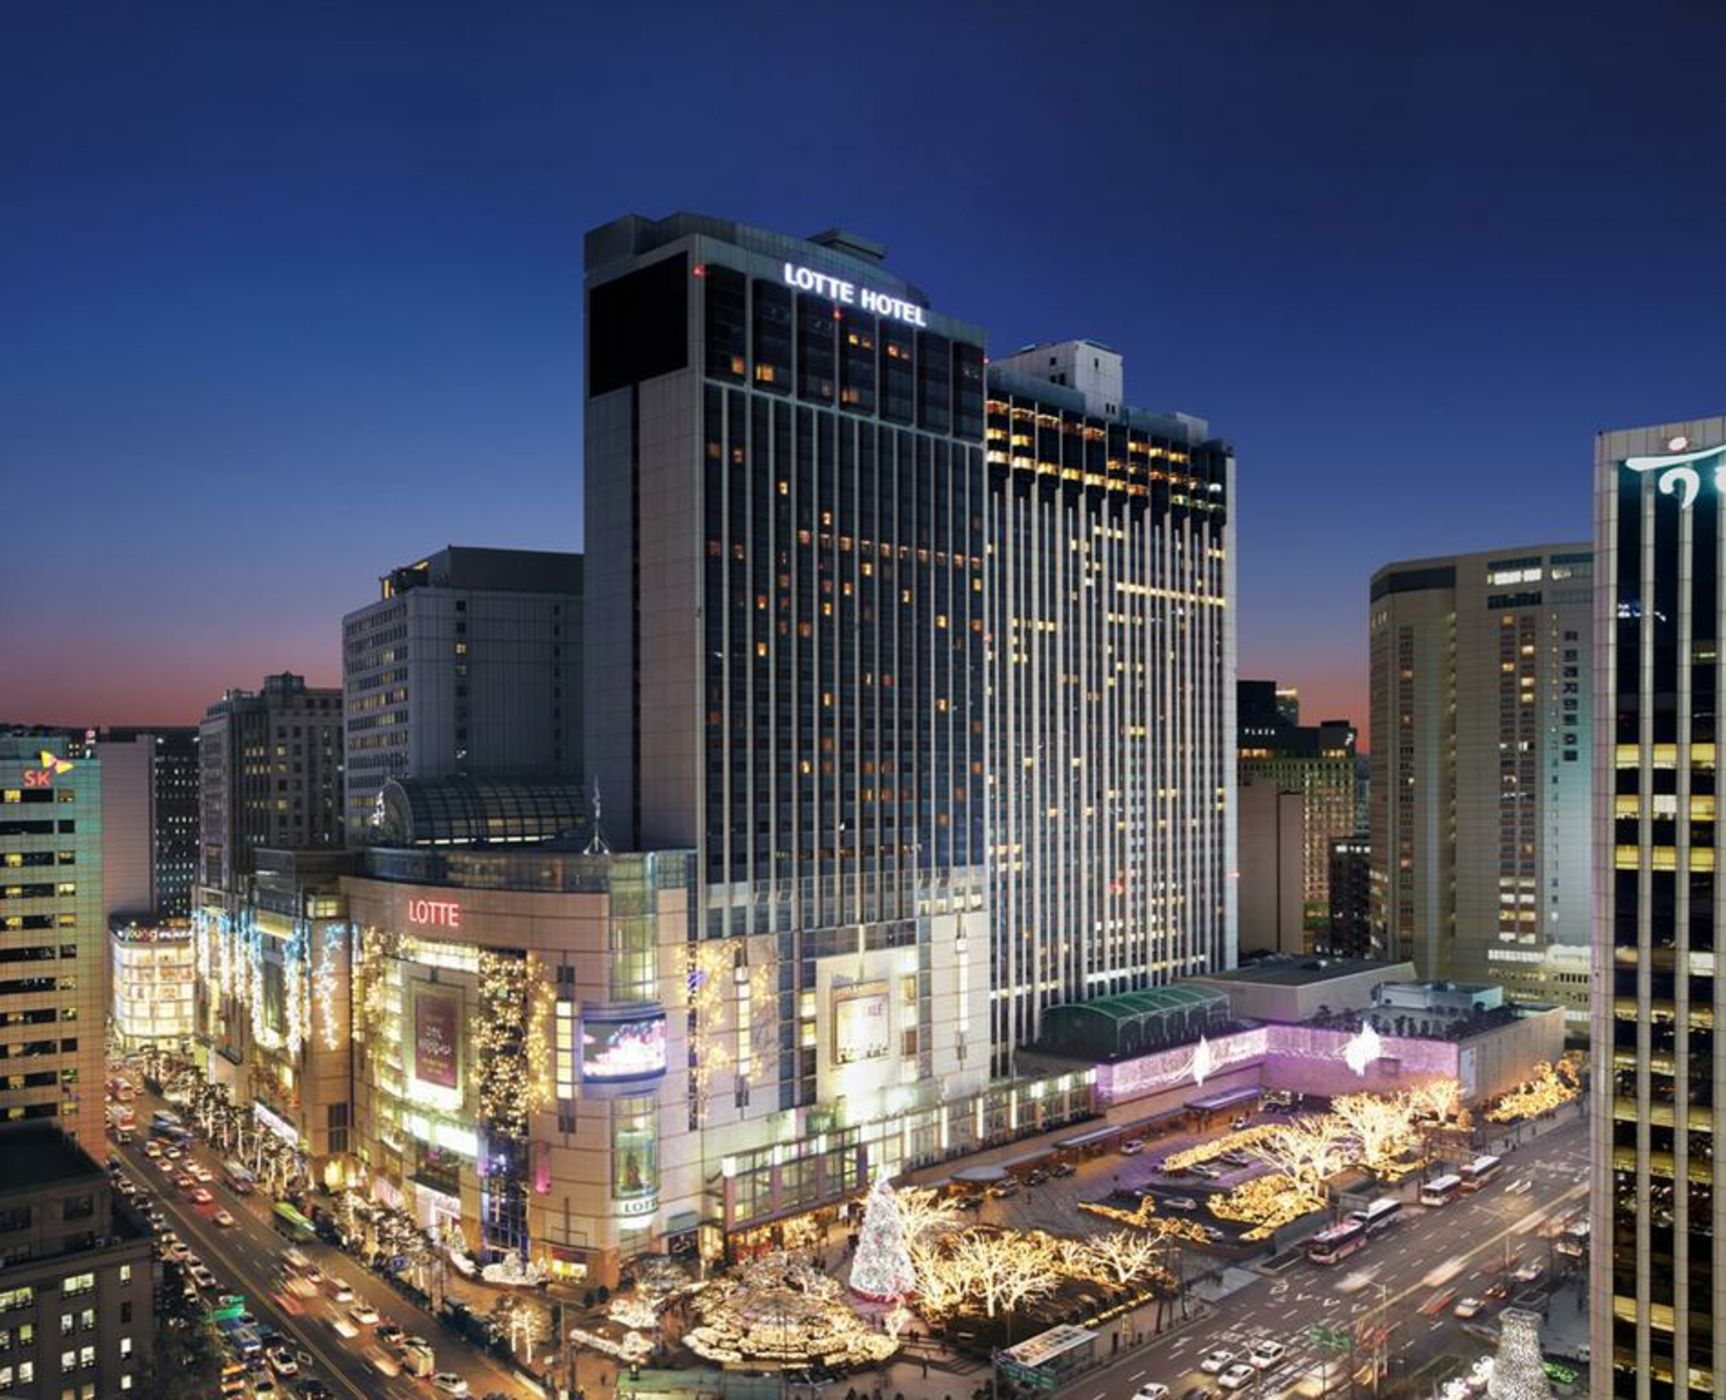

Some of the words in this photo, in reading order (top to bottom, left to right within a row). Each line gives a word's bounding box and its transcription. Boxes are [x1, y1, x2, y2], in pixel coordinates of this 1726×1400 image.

[784, 262, 854, 303] LOTTE
[861, 288, 926, 327] HOTEL
[23, 769, 51, 788] SK
[409, 900, 459, 927] LOTTE
